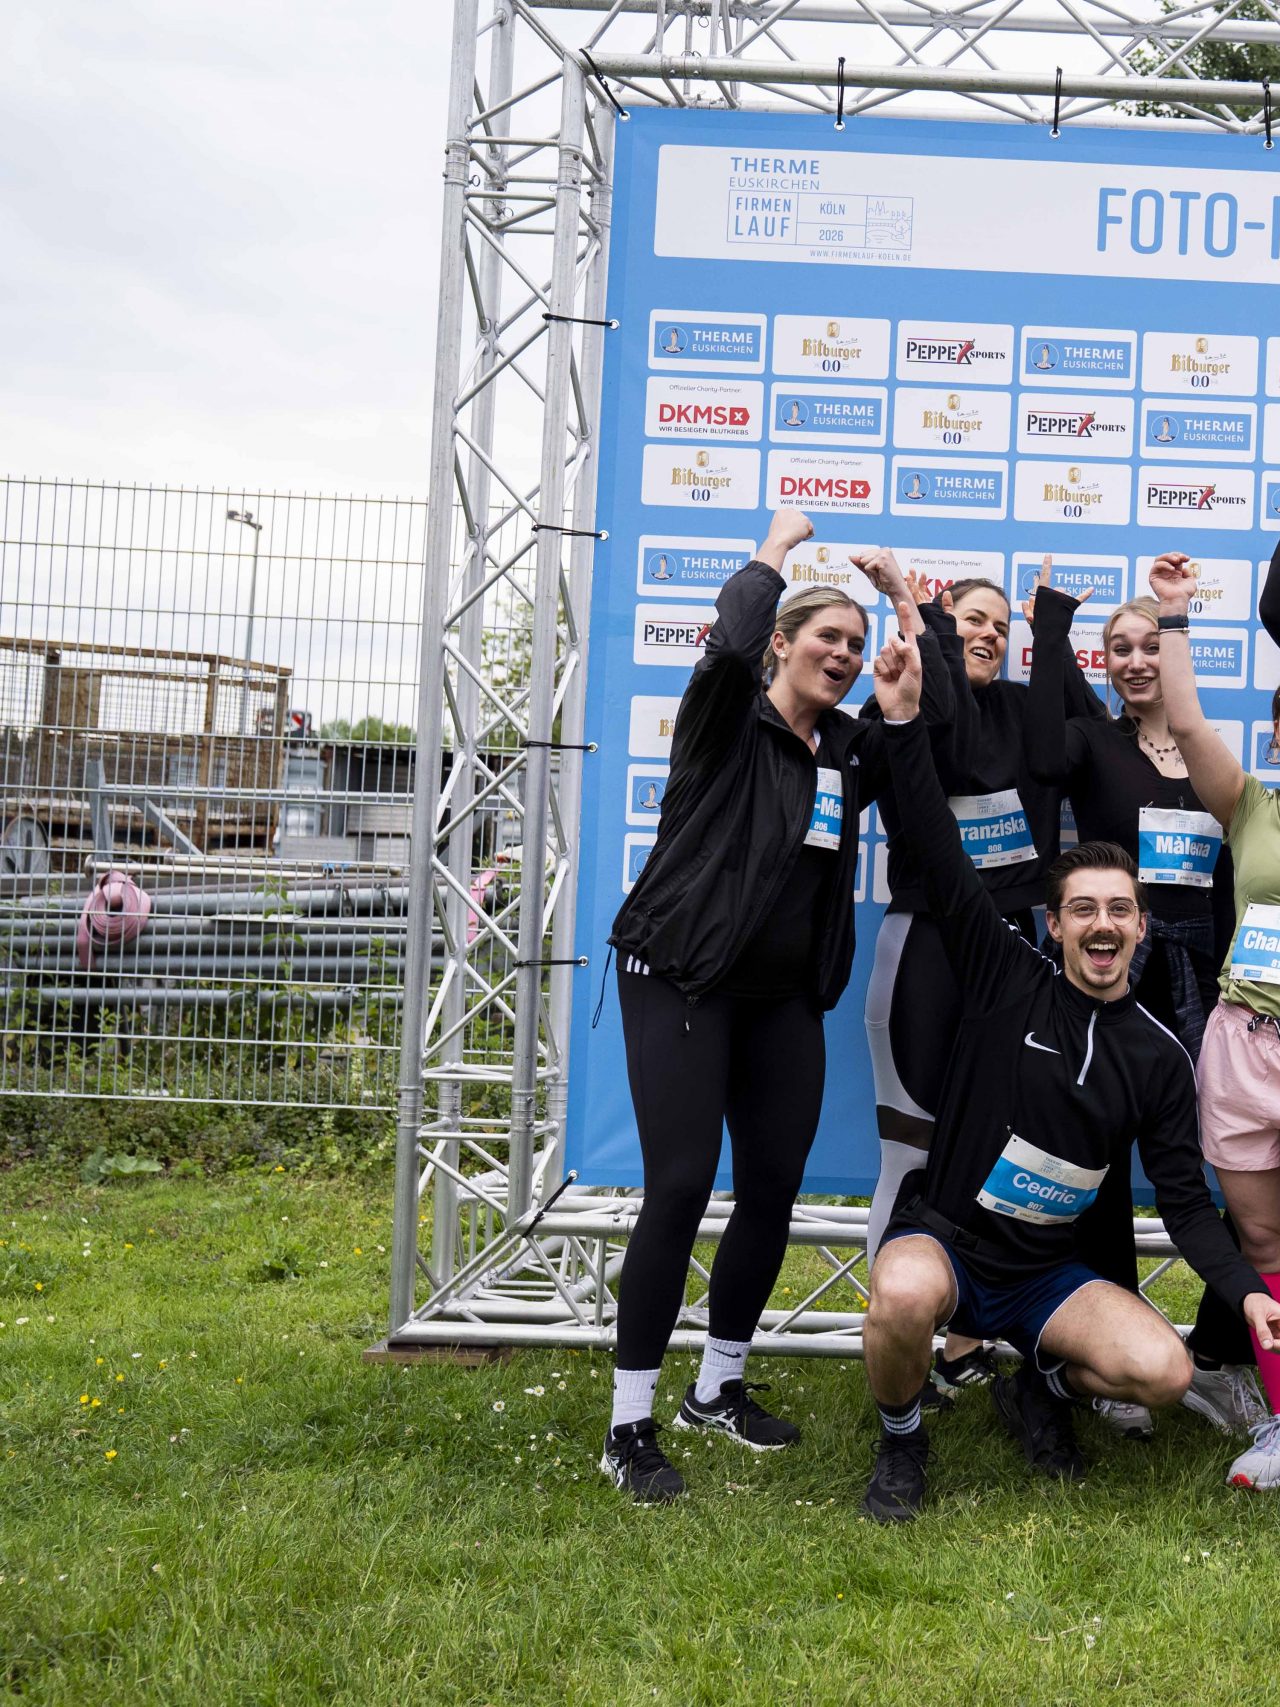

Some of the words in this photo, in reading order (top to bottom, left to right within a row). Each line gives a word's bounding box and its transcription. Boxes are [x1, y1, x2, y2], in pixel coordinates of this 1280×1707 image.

[730, 157, 820, 175] THERME
[729, 177, 820, 190] EUSKIRCHEN
[736, 197, 792, 213] FIRMEN
[819, 202, 846, 215] KÖLN
[734, 216, 790, 238] LAUF
[819, 229, 844, 242] 2026
[692, 329, 753, 343] THERME
[692, 343, 753, 354] EUSKIRCHEN
[801, 337, 862, 361] Bitburger
[969, 350, 1005, 359] SPORTS
[1063, 346, 1123, 360] THERME
[821, 359, 840, 372] 0.0
[1063, 360, 1123, 371] EUSKIRCHEN
[1171, 355, 1231, 377] Bitburger
[1191, 376, 1210, 389] 0.0
[658, 403, 728, 425] DKMS
[813, 402, 874, 416] THERME
[813, 416, 874, 427] EUSKIRCHEN
[922, 410, 983, 433] Bitburger
[1090, 423, 1126, 432] SPORTS
[1184, 419, 1243, 433] THERME
[674, 426, 707, 434] BESIEGEN
[942, 432, 961, 445] 0.0
[1183, 433, 1243, 443] EUSKIRCHEN
[670, 467, 731, 490] Bitburger
[935, 475, 995, 489] THERME
[780, 476, 849, 498] DKMS
[691, 488, 710, 502] 0.0
[934, 489, 995, 500] EUSKIRCHEN
[1043, 483, 1103, 506] Bitburger
[1210, 495, 1246, 505] SPORTS
[795, 499, 829, 507] BESIEGEN
[831, 501, 870, 509] BLUTKREBS
[1063, 505, 1082, 518] 0.0
[682, 556, 742, 570] THERME
[791, 563, 852, 586] Bitburger
[1055, 571, 1115, 585] THERME
[1193, 660, 1235, 669] KIRCHEN
[960, 816, 1027, 842] ranziska
[988, 844, 1002, 853] 808
[1012, 1172, 1077, 1204] Cedric
[1026, 1201, 1045, 1212] 807
